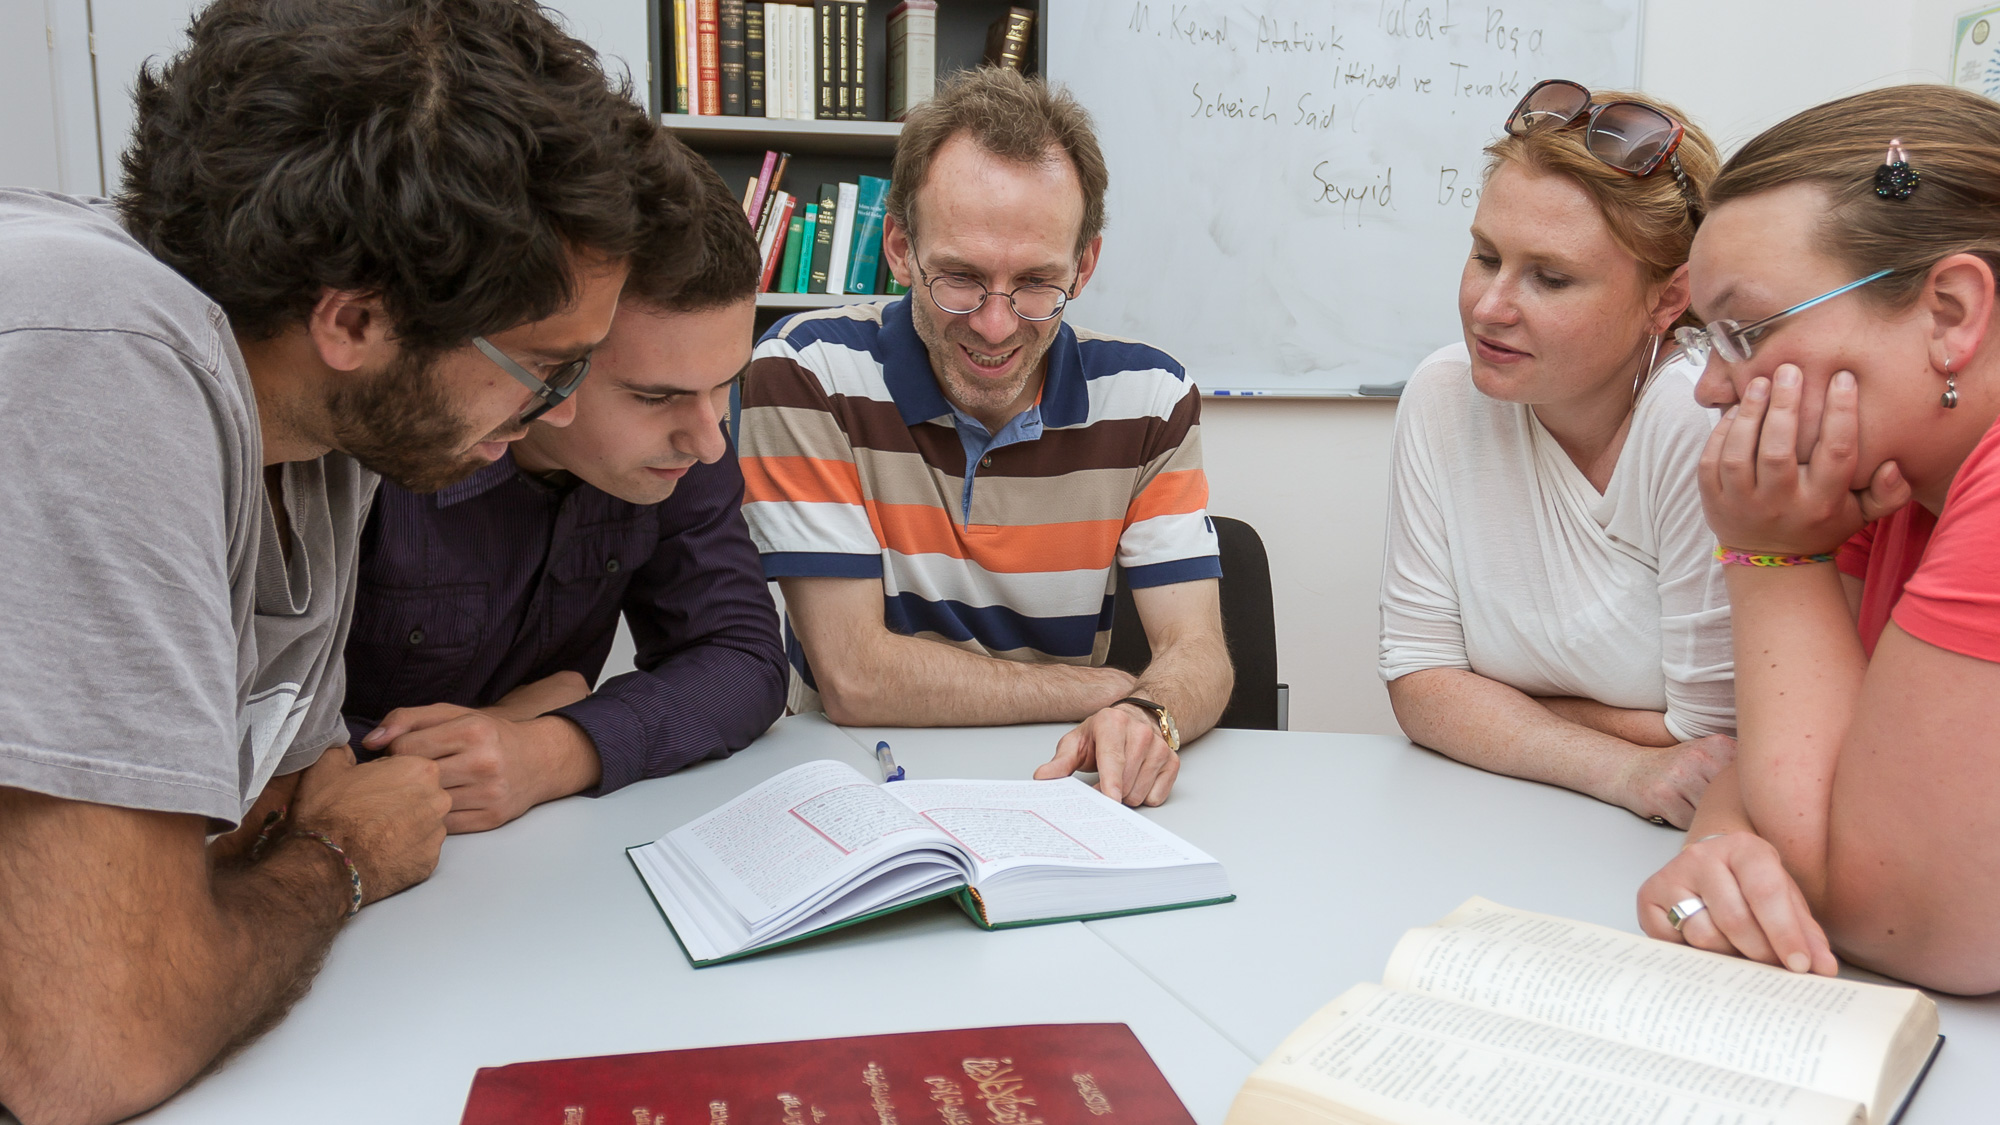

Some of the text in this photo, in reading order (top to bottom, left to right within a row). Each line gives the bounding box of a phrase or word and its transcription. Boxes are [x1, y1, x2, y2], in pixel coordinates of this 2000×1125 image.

[1256, 14, 1345, 53] Atatürk
[1191, 83, 1278, 125] Scheich
[1294, 92, 1335, 131] Said
[1312, 160, 1397, 230] Seyyid
